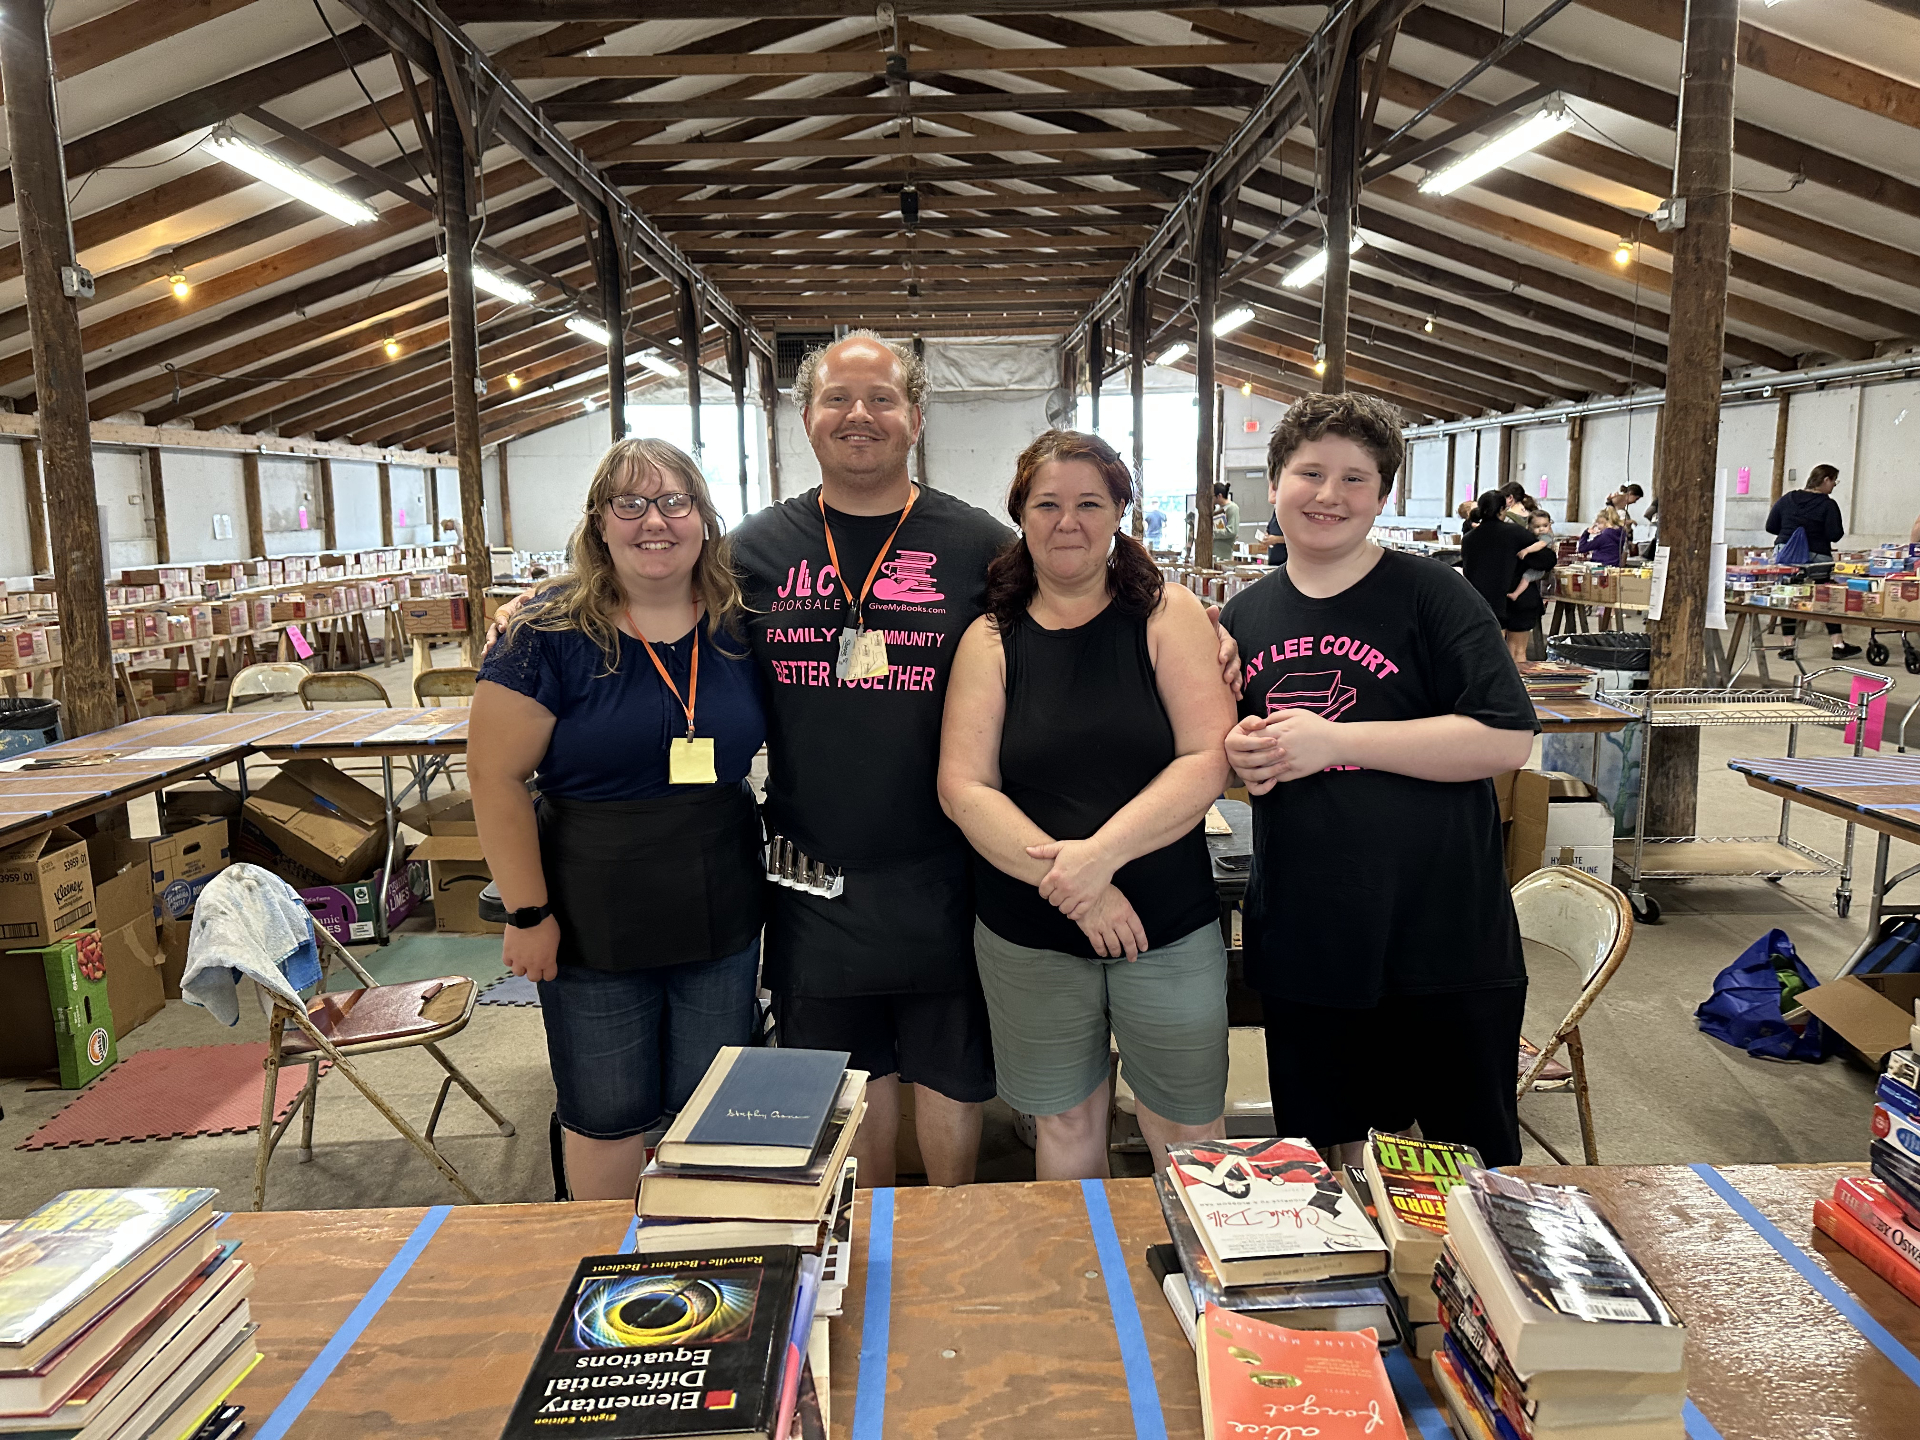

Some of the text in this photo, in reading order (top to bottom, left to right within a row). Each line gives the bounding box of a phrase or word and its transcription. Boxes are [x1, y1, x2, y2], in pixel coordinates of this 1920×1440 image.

[771, 599, 841, 612] BOOKSALE
[868, 602, 946, 614] GiveMyBooks.com
[766, 628, 837, 643] FAMILY
[866, 628, 944, 648] MMUNITY
[1244, 634, 1399, 692] AY LEE COURT
[771, 660, 830, 687] BETTER
[1551, 856, 1583, 864] HYTE
[23, 872, 33, 881] 01
[54, 880, 84, 905] Kleenex
[389, 887, 409, 912] LIMES
[1375, 1134, 1395, 1143] NOVEL
[1392, 1196, 1446, 1217] FORD
[1206, 1208, 1263, 1228] Dolls
[592, 1255, 763, 1273] Rainville Bedient Bedient
[1214, 1315, 1367, 1348] LIANE MORIARTY
[576, 1347, 712, 1370] Equations
[544, 1369, 706, 1396] Differential
[538, 1391, 701, 1413] Elementary
[534, 1413, 617, 1426] Eighth Edition
[1262, 1394, 1383, 1434] forgot
[1227, 1420, 1320, 1440] alice
